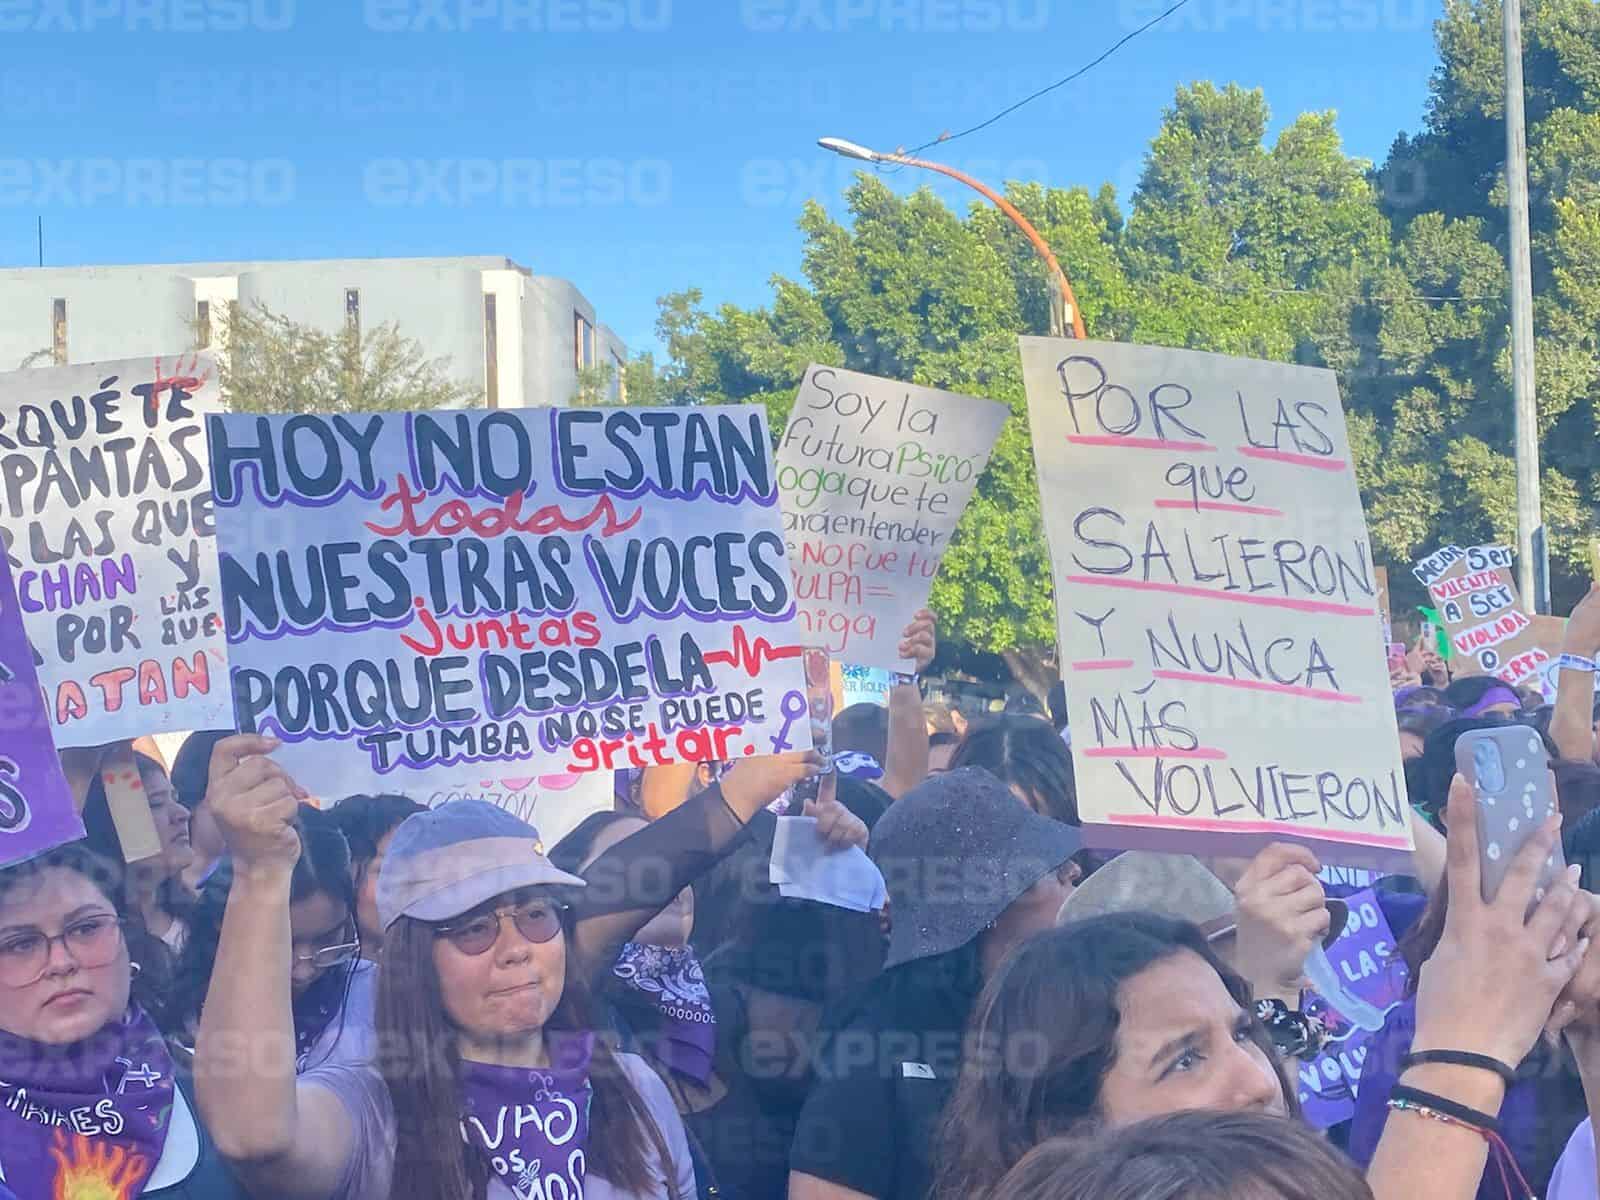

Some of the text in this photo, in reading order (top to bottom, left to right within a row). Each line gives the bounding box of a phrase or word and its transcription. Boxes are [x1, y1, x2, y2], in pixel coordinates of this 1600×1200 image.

[131, 377, 200, 428] TE
[808, 369, 936, 435] Soy la
[1056, 355, 1334, 456] POR LAS
[209, 409, 771, 500] HOY NO ESTAN
[783, 416, 893, 472] futura
[365, 471, 642, 537] todas
[847, 477, 909, 511] que
[914, 481, 948, 514] te
[1164, 461, 1257, 513] que
[29, 510, 116, 564] LAS
[131, 490, 215, 546] QUE
[831, 512, 944, 547] entender
[1071, 506, 1375, 602] SALIERON
[167, 540, 200, 593] Y
[221, 531, 789, 639] NUESTRAS VOCES
[801, 540, 845, 567] NO
[847, 542, 899, 573] fue
[160, 587, 210, 616] LAS
[790, 569, 862, 606] ULPA
[1445, 602, 1461, 622] A
[56, 605, 217, 663] POR QUE
[400, 596, 602, 656] juntas
[1074, 607, 1341, 692] Y NUNCA
[1455, 612, 1528, 652] VIOLADA
[44, 650, 210, 725] ATAN
[236, 632, 714, 736] PORQUE DESDE LA
[1481, 649, 1498, 669] O
[1494, 650, 1549, 684] ERTA
[366, 688, 756, 769] TUMBA NO SE PUEDE
[1089, 680, 1200, 753] MÁS
[566, 723, 756, 773] gritar.
[1114, 758, 1406, 829] VOLVIERON
[1340, 941, 1391, 982] LAS
